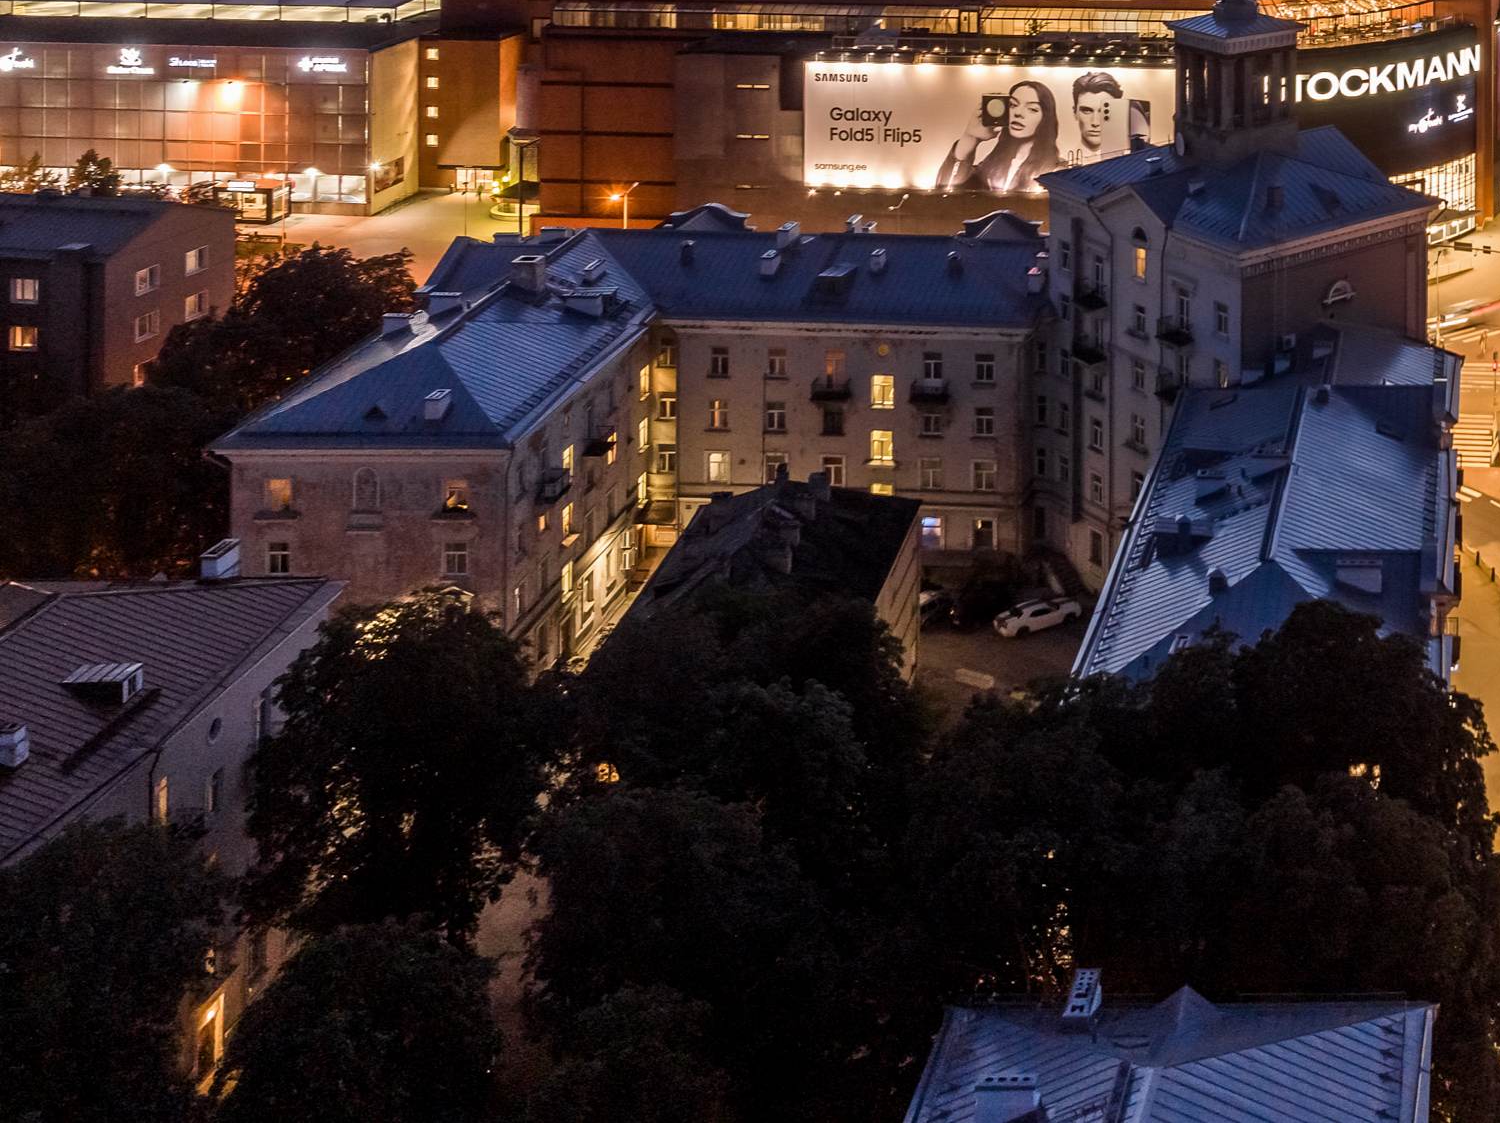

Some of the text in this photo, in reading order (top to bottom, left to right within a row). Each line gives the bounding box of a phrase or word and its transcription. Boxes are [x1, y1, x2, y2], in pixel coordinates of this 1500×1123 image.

[814, 72, 869, 83] SAMSUNG
[1263, 44, 1482, 105] TOCKMANN
[829, 107, 893, 127] Galaxy
[829, 127, 923, 147] Fold5 Flip5
[814, 162, 868, 173] samsung.ee
